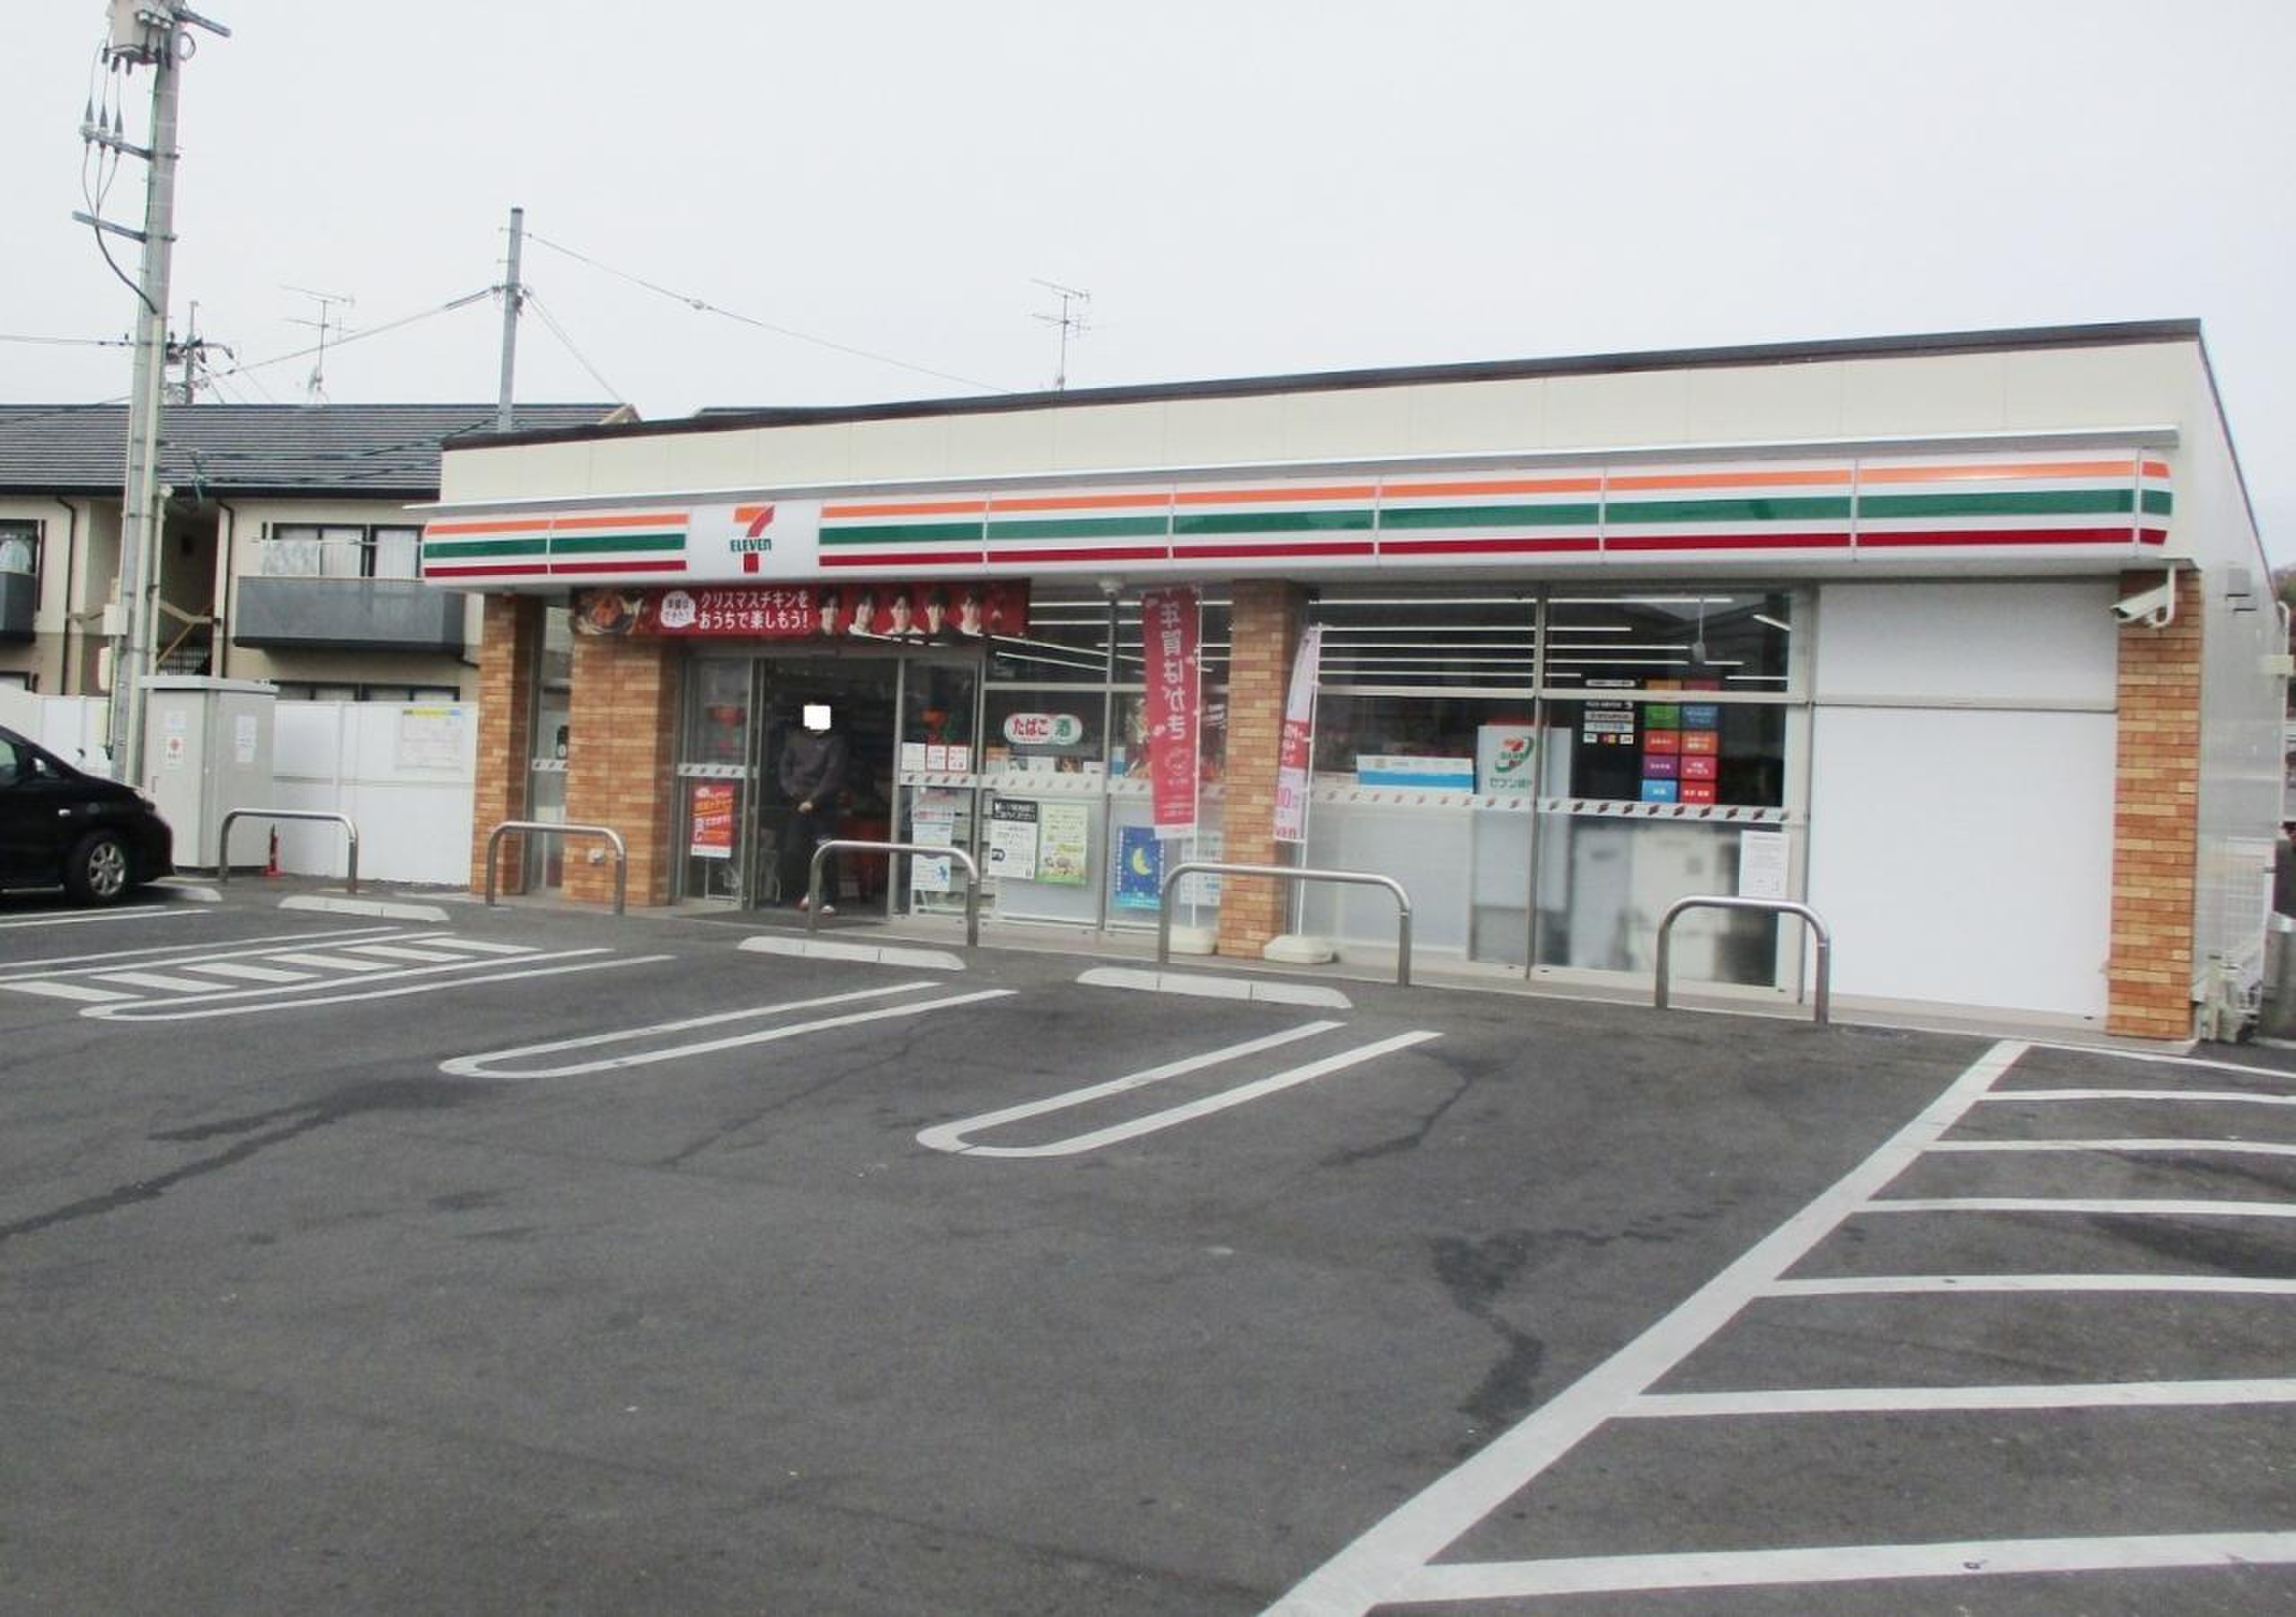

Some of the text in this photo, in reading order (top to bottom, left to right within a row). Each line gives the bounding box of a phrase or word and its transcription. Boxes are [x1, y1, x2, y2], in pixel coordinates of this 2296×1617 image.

[734, 504, 775, 574] 7
[701, 589, 808, 609] クリスマスチキンを
[1011, 718, 1050, 736] たばこ
